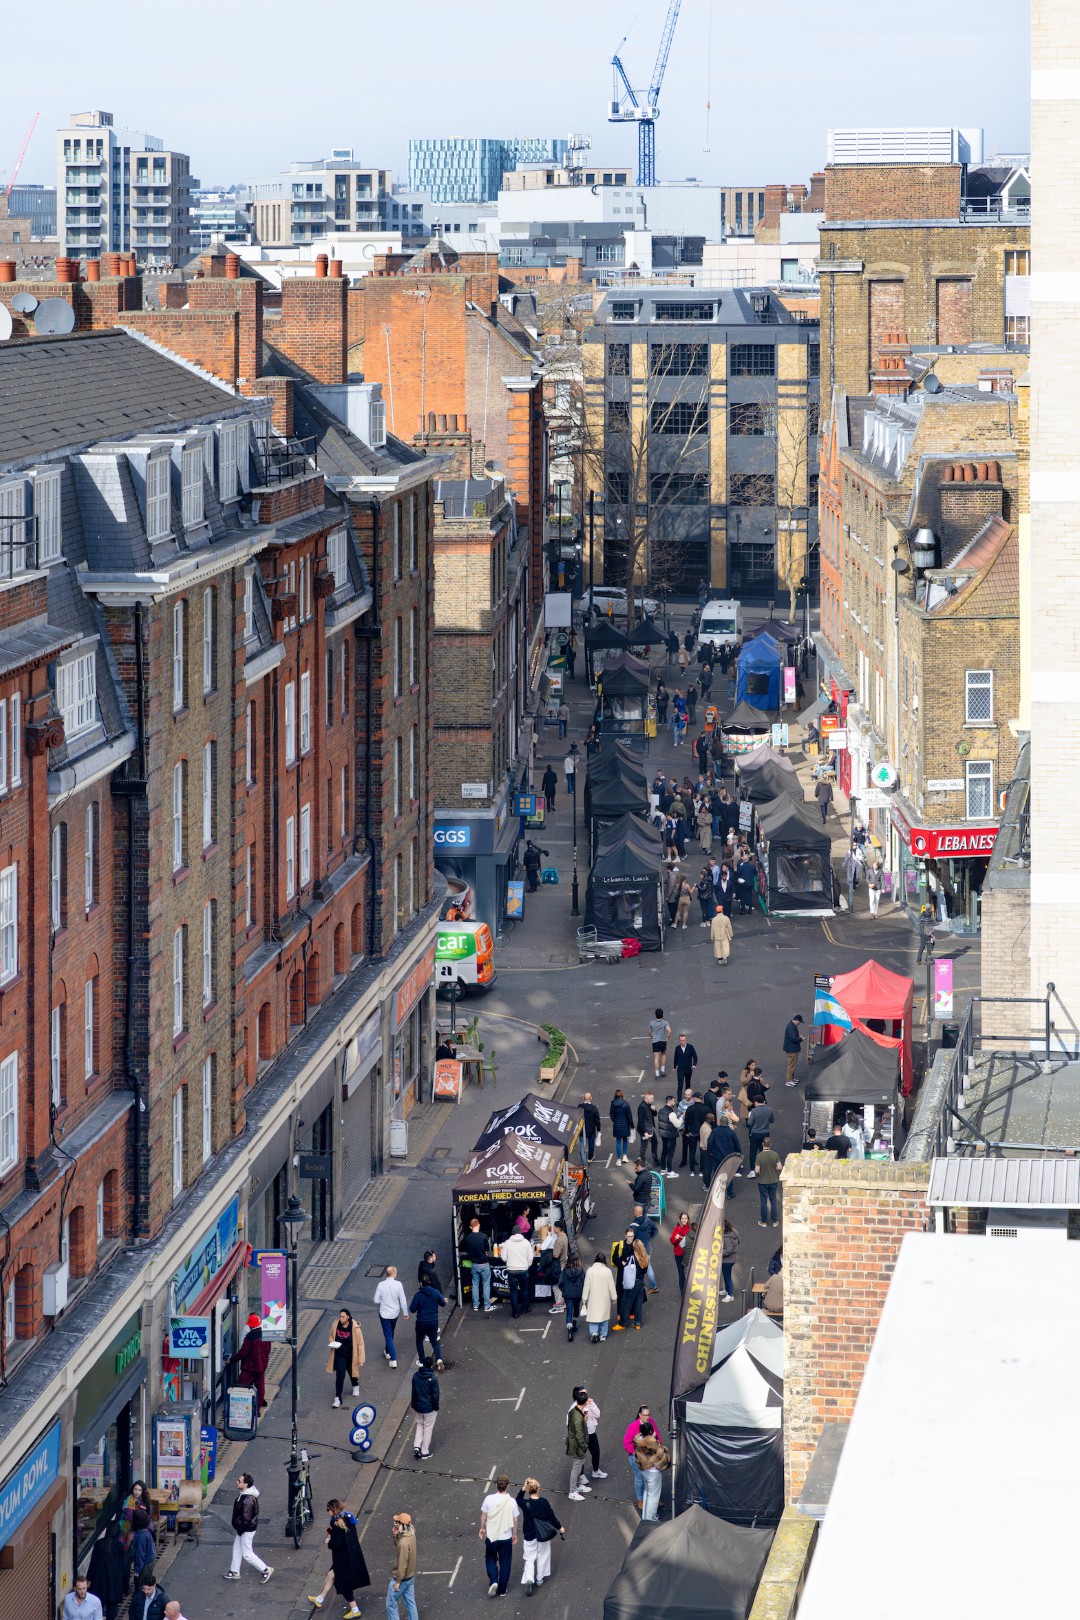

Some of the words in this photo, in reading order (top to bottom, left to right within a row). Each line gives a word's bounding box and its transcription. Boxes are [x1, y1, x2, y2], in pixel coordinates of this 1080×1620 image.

[434, 830, 466, 843] GGS
[937, 835, 997, 851] LEBANES
[441, 965, 453, 976] a
[486, 1162, 521, 1178] ROK
[458, 1193, 490, 1202] KOREAN
[491, 1192, 512, 1200] FRIED
[514, 1191, 546, 1199] CHICKEN
[493, 1268, 509, 1281] RO
[690, 1247, 710, 1294] YUM
[695, 1285, 718, 1374] CHINESE
[707, 1225, 723, 1283] FOOD
[682, 1298, 702, 1345] YUM
[179, 1328, 199, 1339] VITA
[178, 1338, 203, 1347] COCO
[22, 1448, 48, 1499] BOWL
